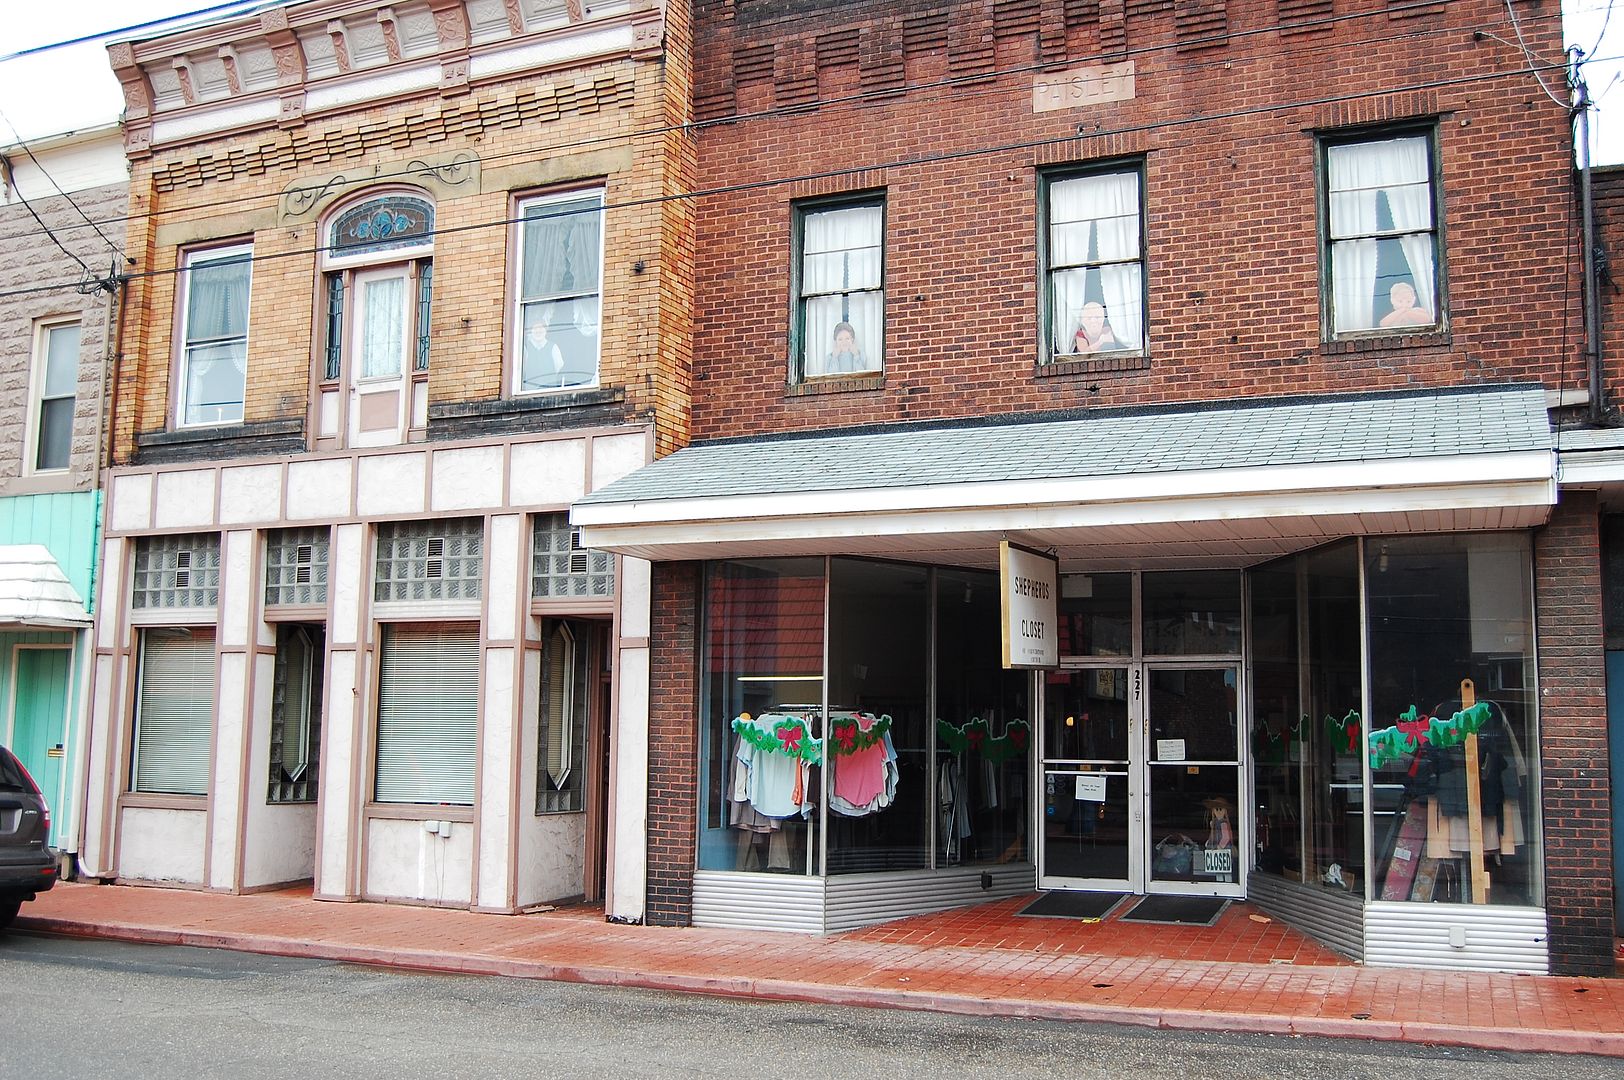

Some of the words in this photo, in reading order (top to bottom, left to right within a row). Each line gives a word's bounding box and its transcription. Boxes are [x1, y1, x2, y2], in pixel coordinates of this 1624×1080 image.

[1037, 68, 1130, 101] PAISLEY
[1015, 576, 1049, 600] SHEPHERDS
[1022, 619, 1045, 640] CLOSET
[1206, 852, 1230, 871] CLOSED
